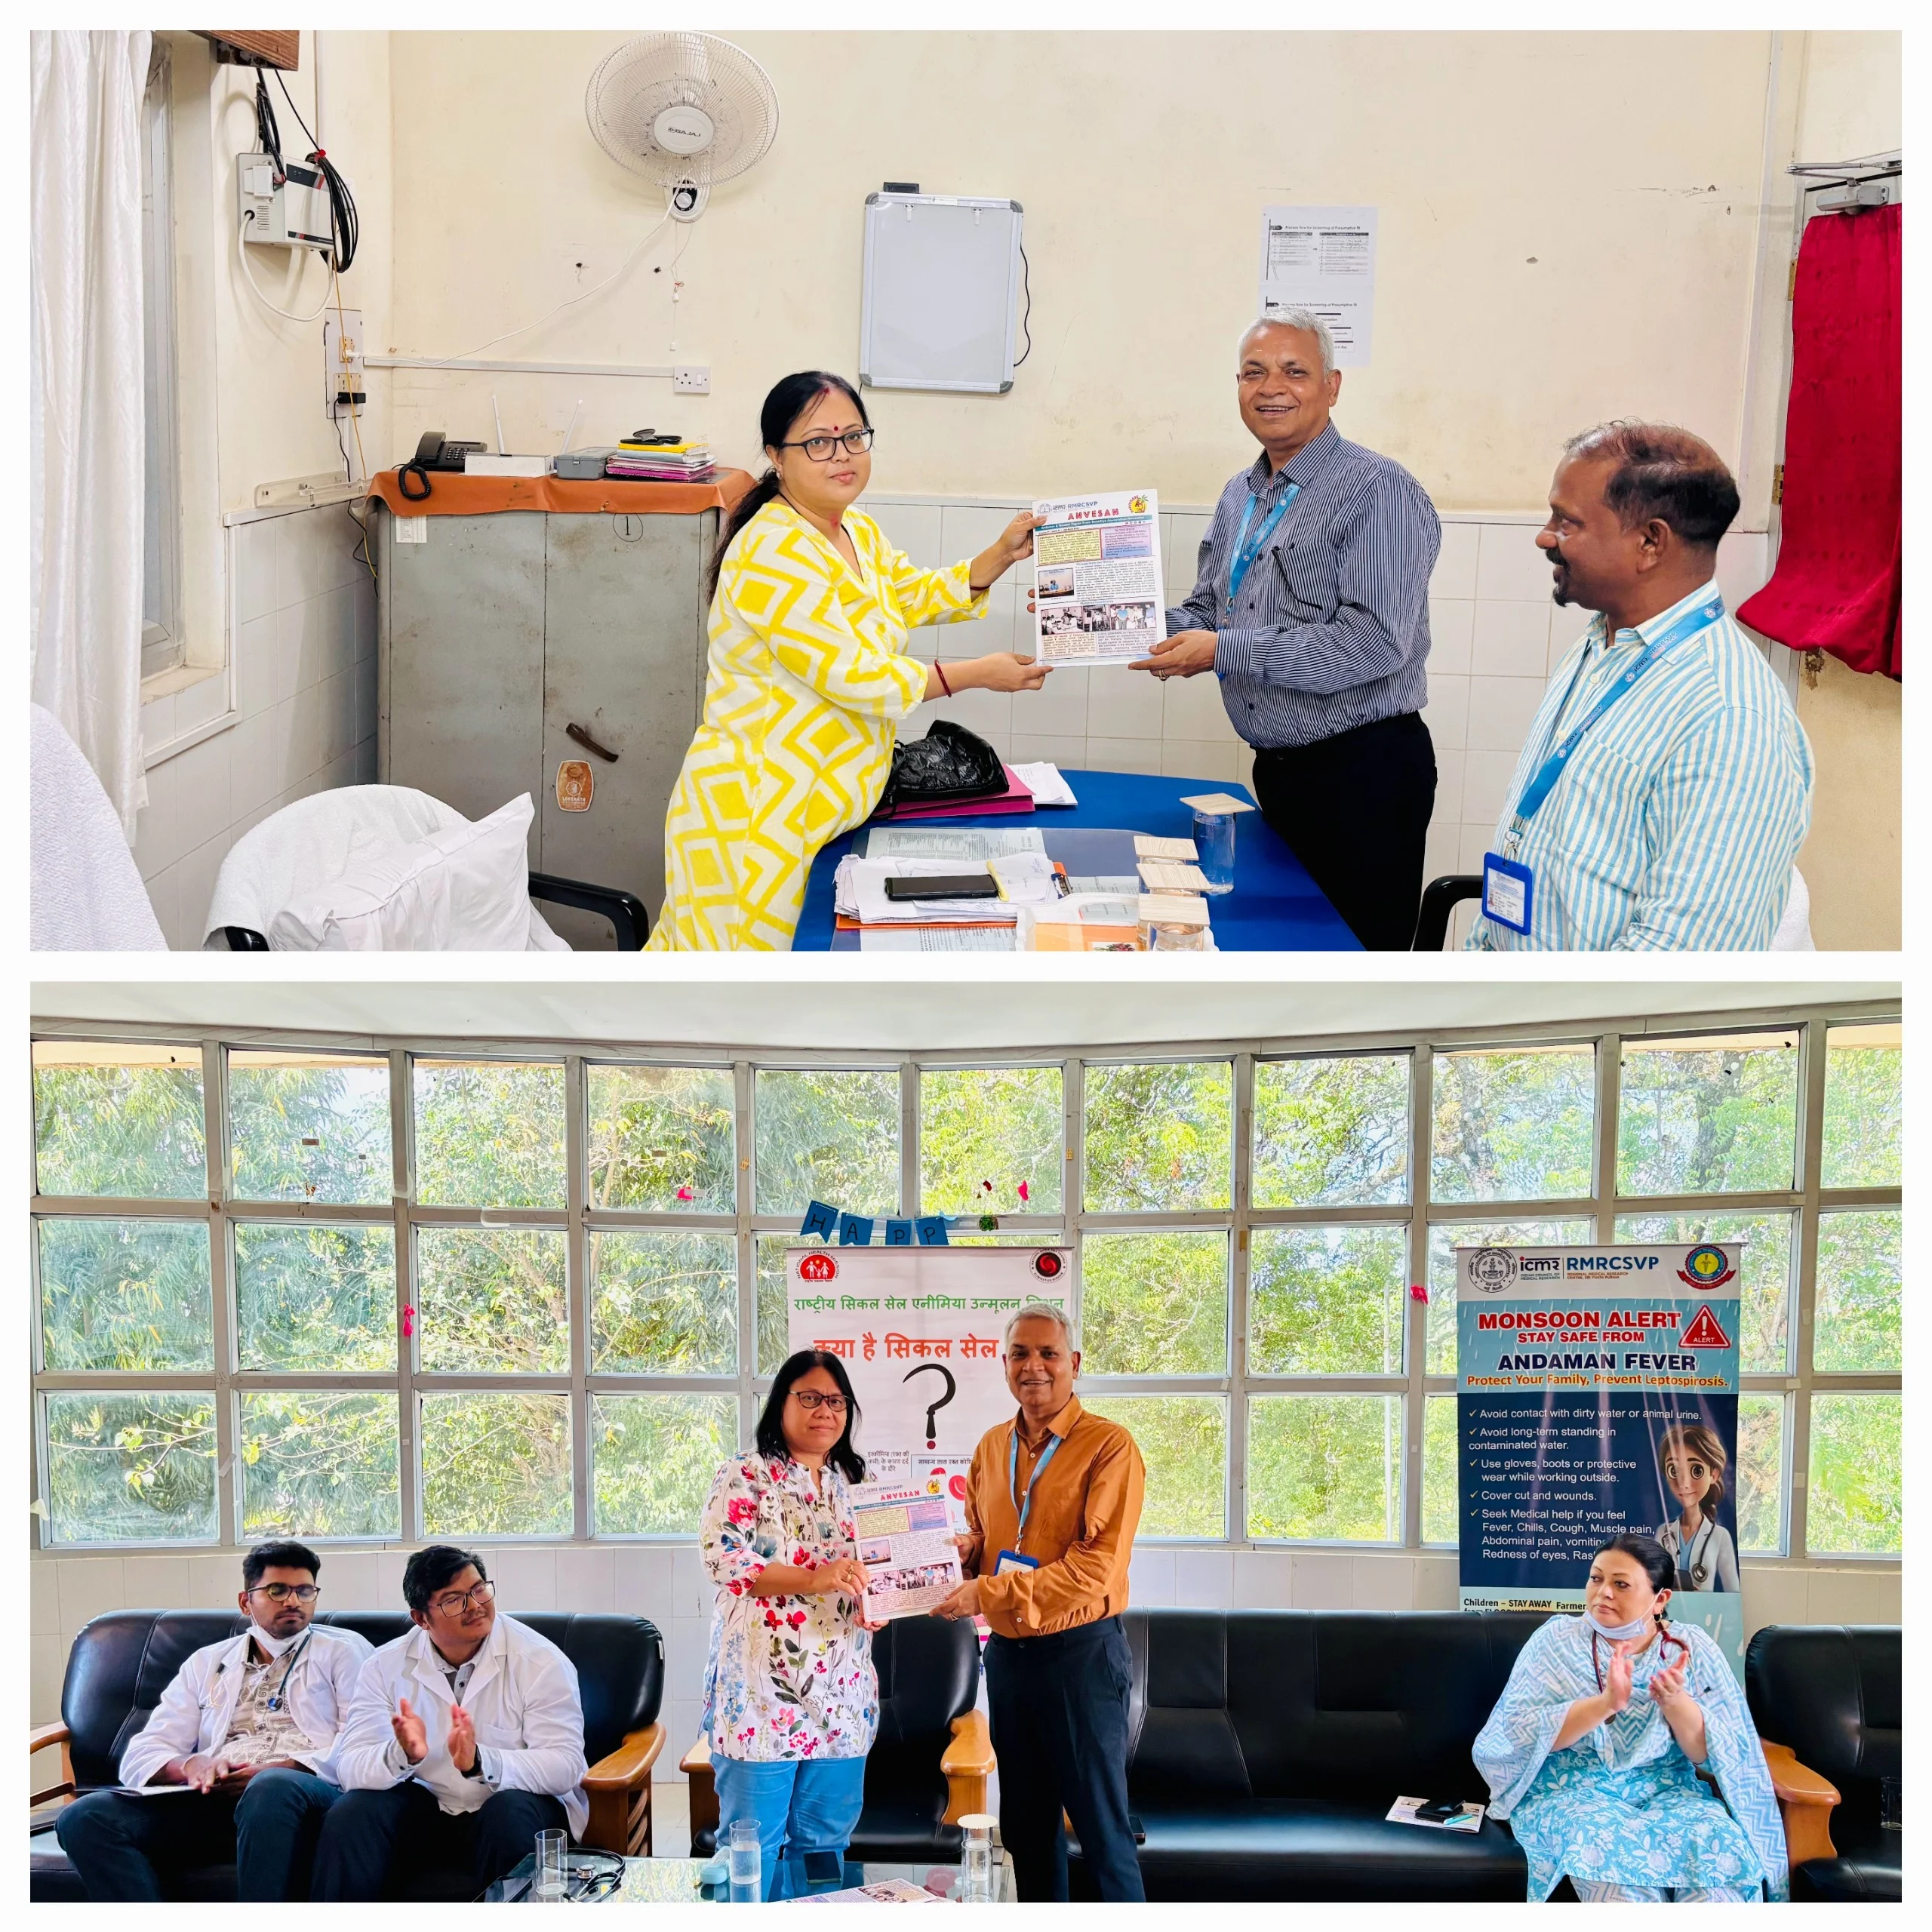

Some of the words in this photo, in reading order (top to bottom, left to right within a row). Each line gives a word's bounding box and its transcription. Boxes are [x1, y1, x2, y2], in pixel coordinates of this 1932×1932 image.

[1068, 508, 1119, 521] ANVESAN
[624, 515, 631, 536] 1
[1567, 1256, 1660, 1271] RMRCSVP
[794, 1295, 836, 1314] राष्ट्रीय
[841, 1294, 879, 1311] सिकल
[884, 1294, 907, 1311] सेल
[912, 1294, 966, 1310] एनीमिया
[970, 1297, 1021, 1315] उन्मूलन
[1478, 1312, 1600, 1330] MONSOON
[1607, 1311, 1682, 1328] ALERT
[1518, 1332, 1555, 1343] STAY
[1559, 1331, 1598, 1343] SAFE
[1602, 1331, 1645, 1343] FROM
[814, 1339, 855, 1359] क्या
[862, 1331, 878, 1361] है
[884, 1332, 952, 1359] सिकल
[959, 1332, 1000, 1359] सेल
[1497, 1354, 1616, 1371] ANDAMAN
[1625, 1353, 1697, 1372] FEVER
[1467, 1375, 1512, 1386] Protect
[1515, 1375, 1544, 1385] Your
[1546, 1374, 1591, 1386] Family,
[1593, 1374, 1642, 1385] Prevent
[1645, 1374, 1728, 1389] Leptospirosis.
[1479, 1410, 1508, 1419] Avoid
[1510, 1410, 1547, 1419] contact
[1549, 1410, 1571, 1418] with
[1573, 1409, 1595, 1420] dirty
[1598, 1410, 1626, 1418] water
[1642, 1409, 1673, 1419] animal
[1675, 1410, 1702, 1420] urine.
[1479, 1427, 1508, 1437] Avoid
[1510, 1427, 1558, 1438] long-term
[1561, 1427, 1604, 1438] standing
[1607, 1427, 1617, 1436] in
[1469, 1441, 1537, 1451] contaminated
[1540, 1441, 1570, 1450] water.
[1481, 1460, 1502, 1469] Use
[1504, 1459, 1540, 1471] gloves,
[1542, 1460, 1571, 1469] boots
[1586, 1460, 1637, 1471] protective
[1481, 1474, 1506, 1482] wear
[1509, 1472, 1535, 1481] while
[1537, 1472, 1577, 1484] working
[1580, 1472, 1620, 1482] outside.
[880, 1490, 921, 1501] ANVESAN
[1481, 1491, 1512, 1500] Cover
[1515, 1491, 1531, 1500] cut
[1532, 1491, 1551, 1500] and
[1554, 1491, 1597, 1501] wounds.
[1481, 1509, 1508, 1518] Seek
[1510, 1509, 1549, 1519] Medical
[1552, 1509, 1574, 1521] help
[1577, 1509, 1583, 1519] if
[1586, 1512, 1604, 1521] you
[1607, 1510, 1626, 1520] feel
[1482, 1523, 1514, 1533] Fever,
[1517, 1523, 1547, 1533] Chills,
[1549, 1523, 1587, 1535] Cough,
[1590, 1524, 1626, 1534] Muscle
[1629, 1524, 1655, 1536] pain,
[1481, 1536, 1534, 1546] Abdominal
[1537, 1537, 1562, 1548] pain,
[1482, 1549, 1527, 1559] Redness
[1529, 1549, 1540, 1559] of
[1542, 1552, 1570, 1561] eyes,
[1463, 1598, 1499, 1607] Children
[1509, 1599, 1527, 1607] STAY
[1528, 1600, 1552, 1608] AWAY
